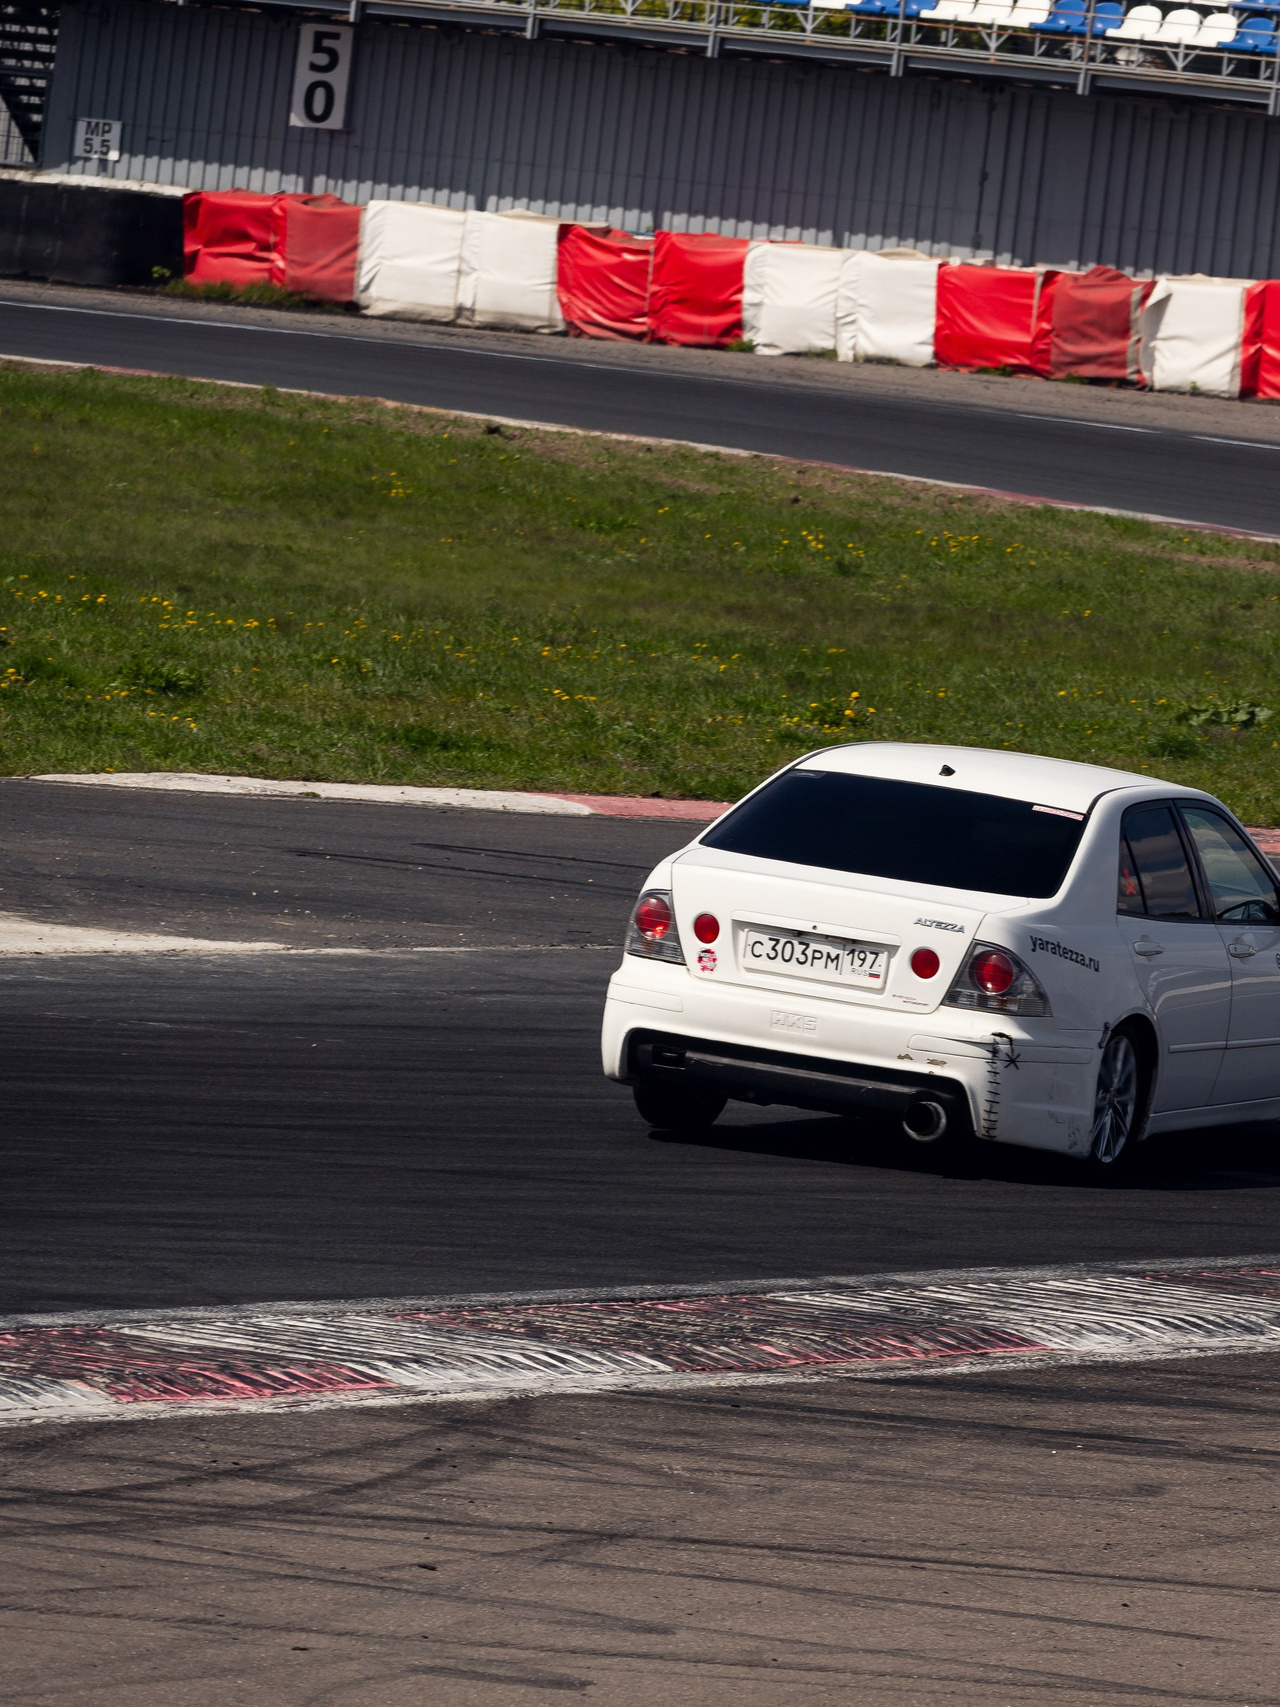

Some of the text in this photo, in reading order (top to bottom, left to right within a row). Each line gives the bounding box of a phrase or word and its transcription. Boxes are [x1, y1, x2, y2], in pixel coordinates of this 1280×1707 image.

[304, 30, 341, 123] 50
[85, 121, 112, 137] MP
[83, 137, 110, 156] 5.5
[913, 917, 965, 934] ALTEZZA
[846, 948, 880, 970] 197
[1029, 935, 1100, 973] yaratezza.ru
[850, 967, 868, 977] RUS
[771, 1011, 818, 1032] HKS
